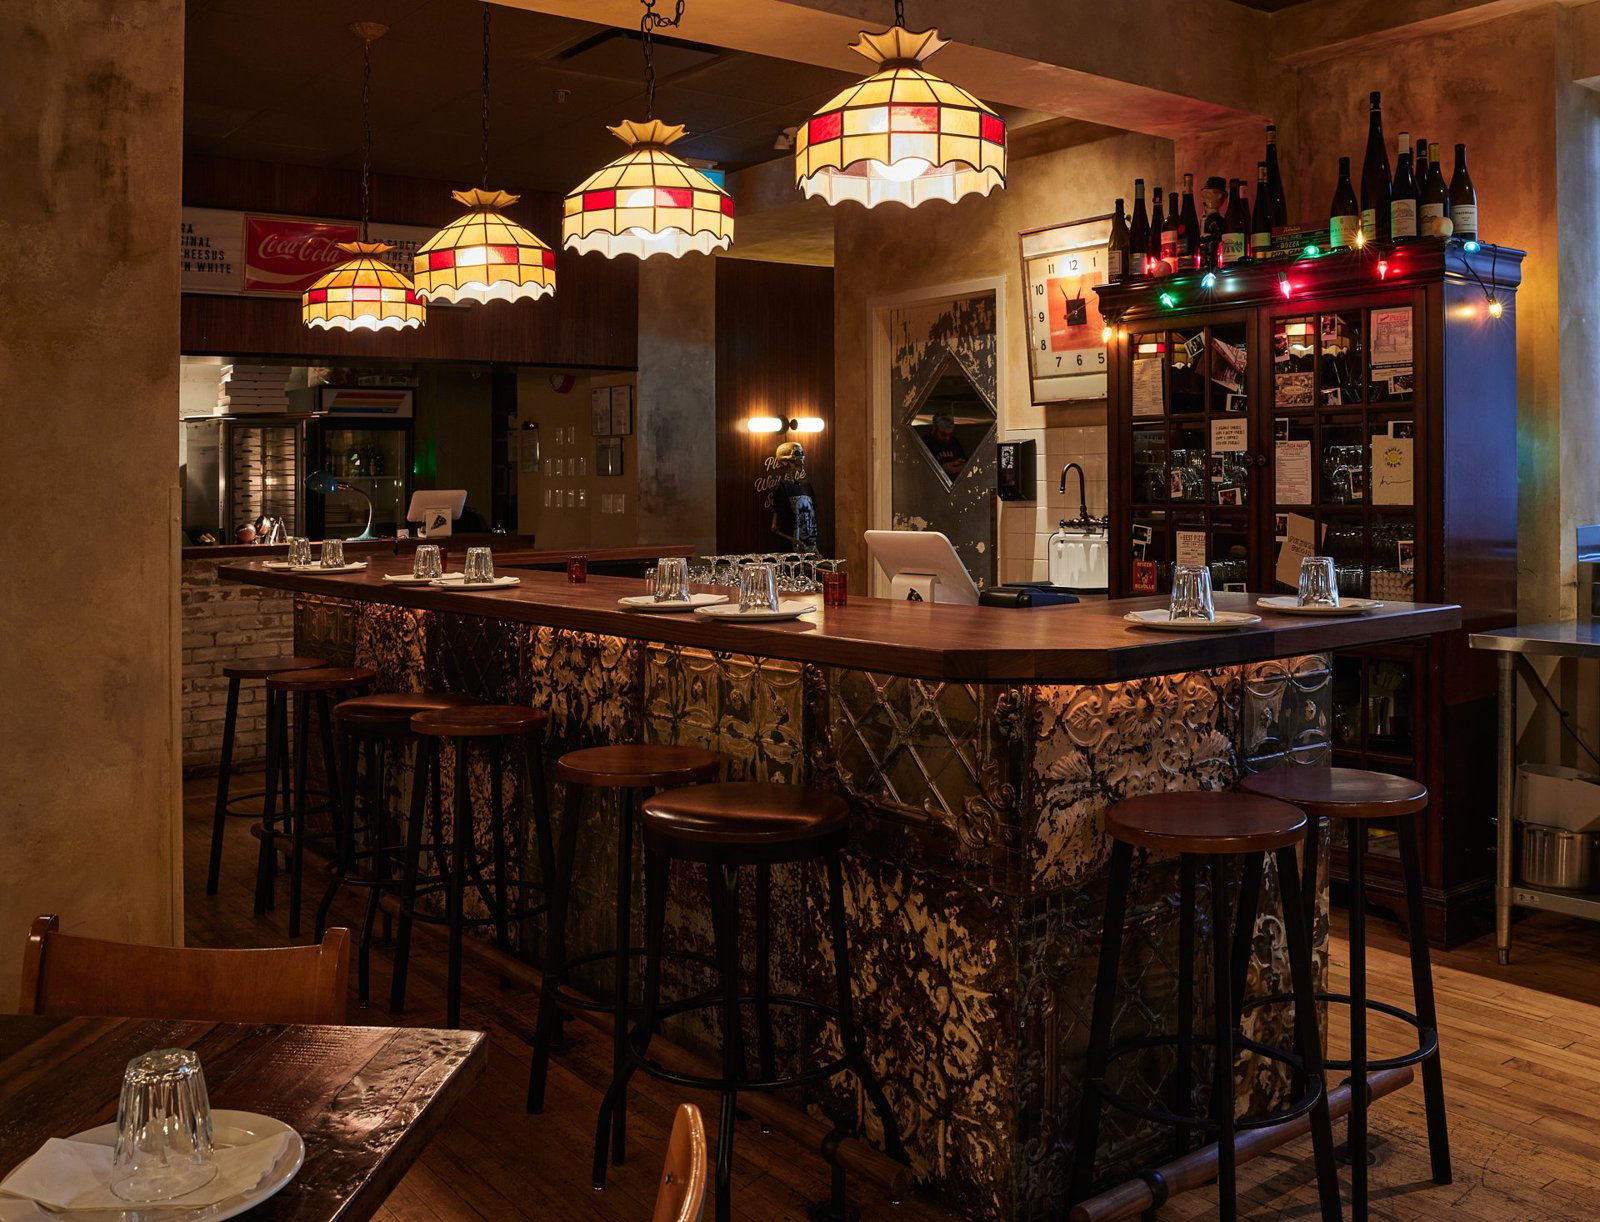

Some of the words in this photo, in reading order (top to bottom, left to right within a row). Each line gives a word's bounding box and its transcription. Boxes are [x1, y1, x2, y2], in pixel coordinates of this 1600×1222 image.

[181, 249, 225, 261] HEESUS
[197, 261, 232, 274] WHITE
[1069, 259, 1078, 271] 12
[1093, 257, 1097, 267] 1
[1048, 264, 1055, 274] 11
[1035, 284, 1044, 295] 10
[1039, 311, 1045, 322] 9
[1040, 339, 1047, 351] 8
[1055, 356, 1062, 367] 7
[1076, 354, 1083, 366] 6
[1098, 352, 1105, 364] 5
